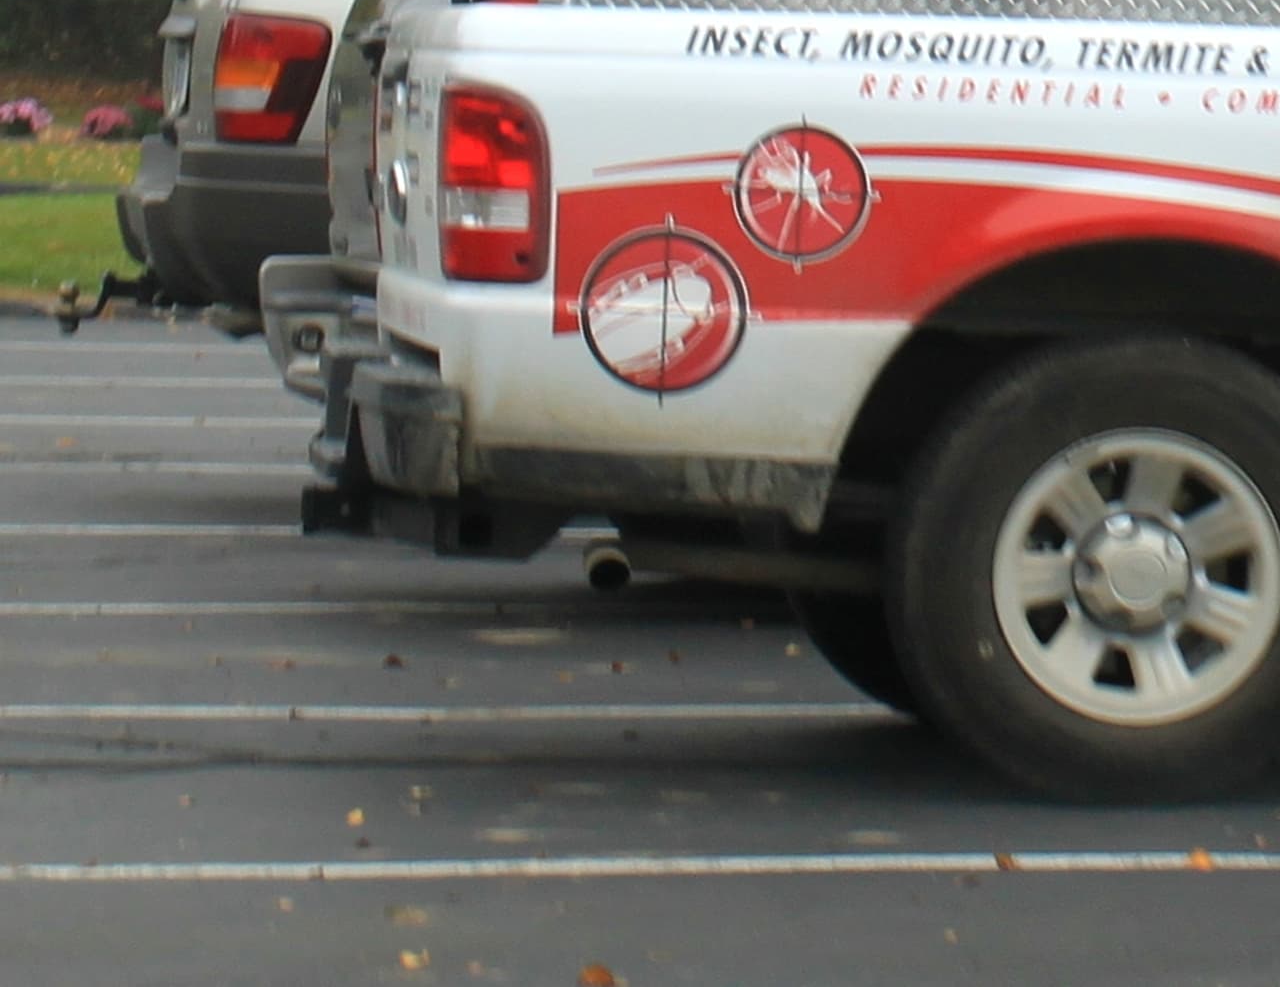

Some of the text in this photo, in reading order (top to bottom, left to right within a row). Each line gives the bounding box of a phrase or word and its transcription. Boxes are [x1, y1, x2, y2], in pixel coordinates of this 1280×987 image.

[685, 25, 820, 62] INSECT,
[840, 29, 1054, 71] MOSQUITO,
[1077, 38, 1233, 74] TERMITE
[1245, 46, 1269, 75] &
[858, 73, 1127, 108] RESIDENTIAL
